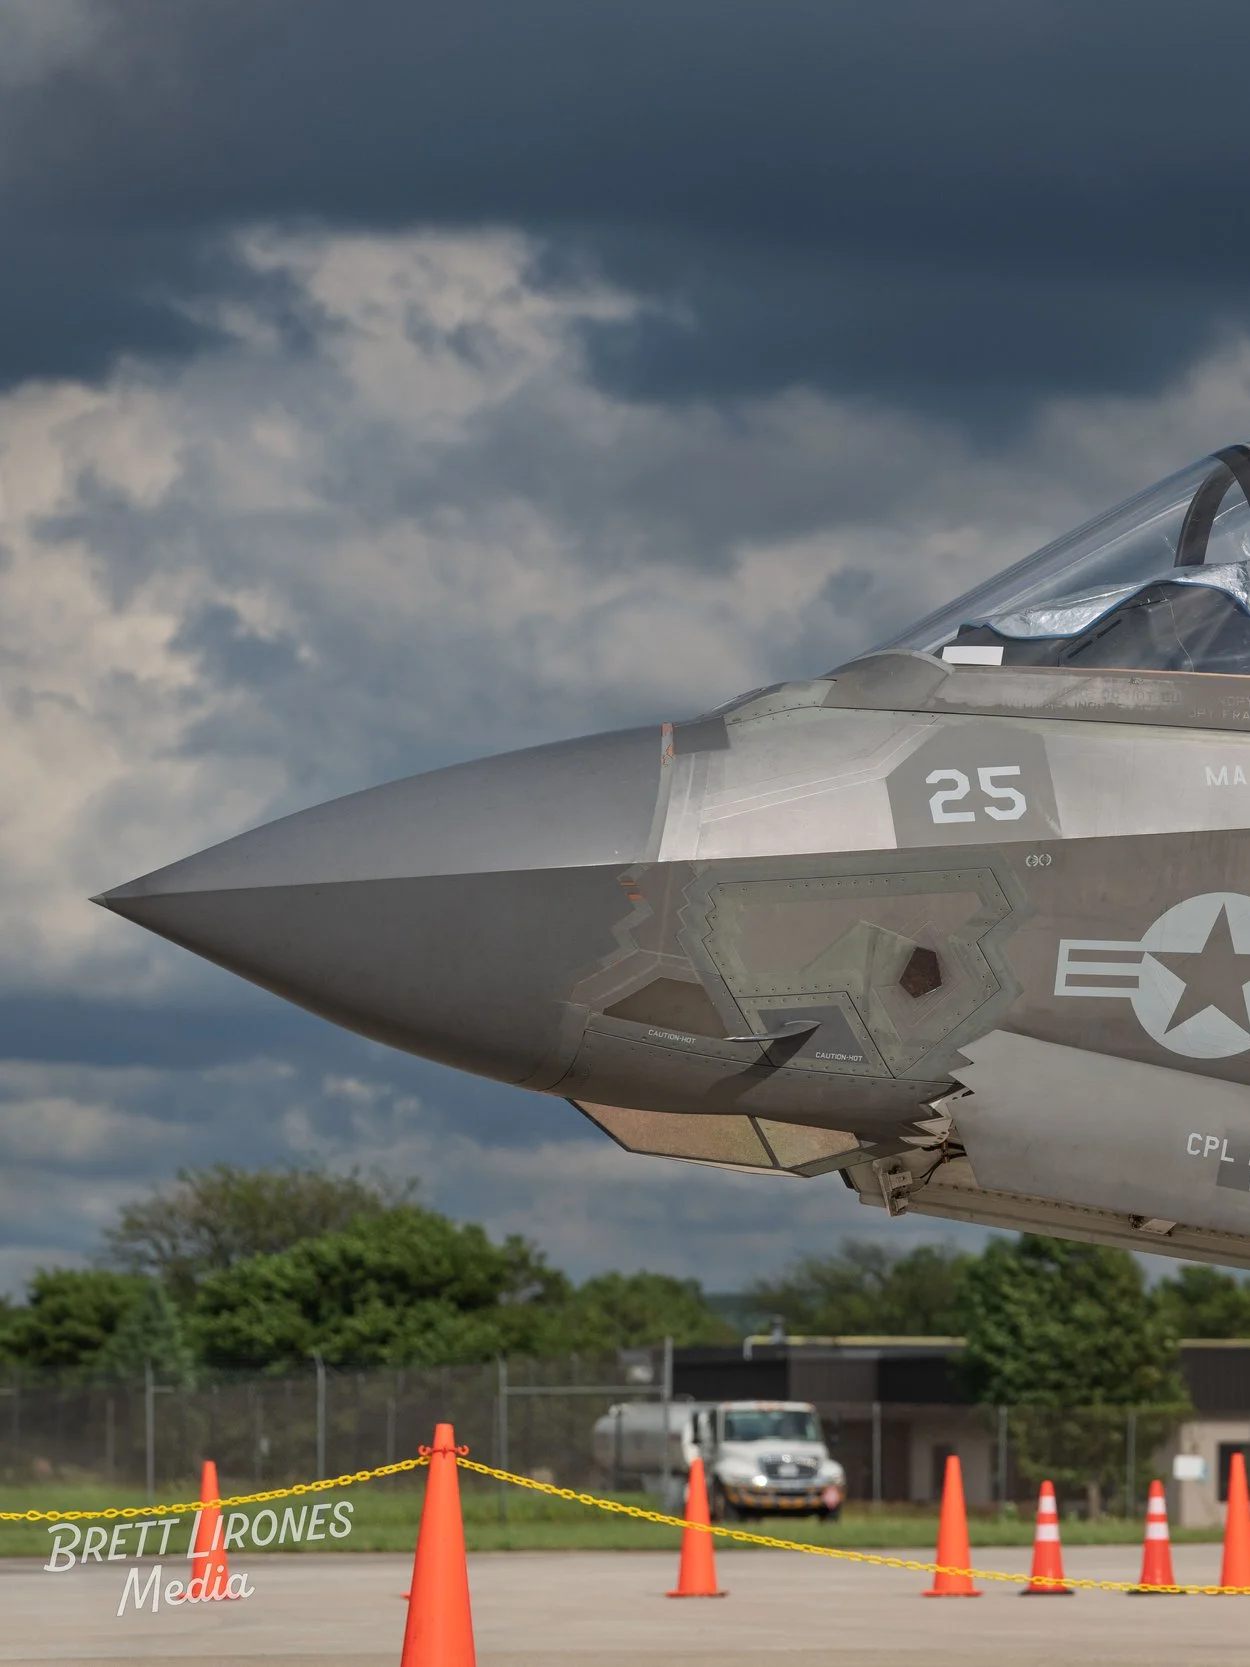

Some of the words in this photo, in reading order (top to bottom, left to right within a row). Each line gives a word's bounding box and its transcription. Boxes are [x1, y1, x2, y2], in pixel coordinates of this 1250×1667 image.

[925, 765, 1027, 824] 25
[648, 1029, 697, 1044] CAUTION-HOT
[815, 1051, 864, 1062] CAUTION-HOT
[1186, 1132, 1235, 1163] CPL
